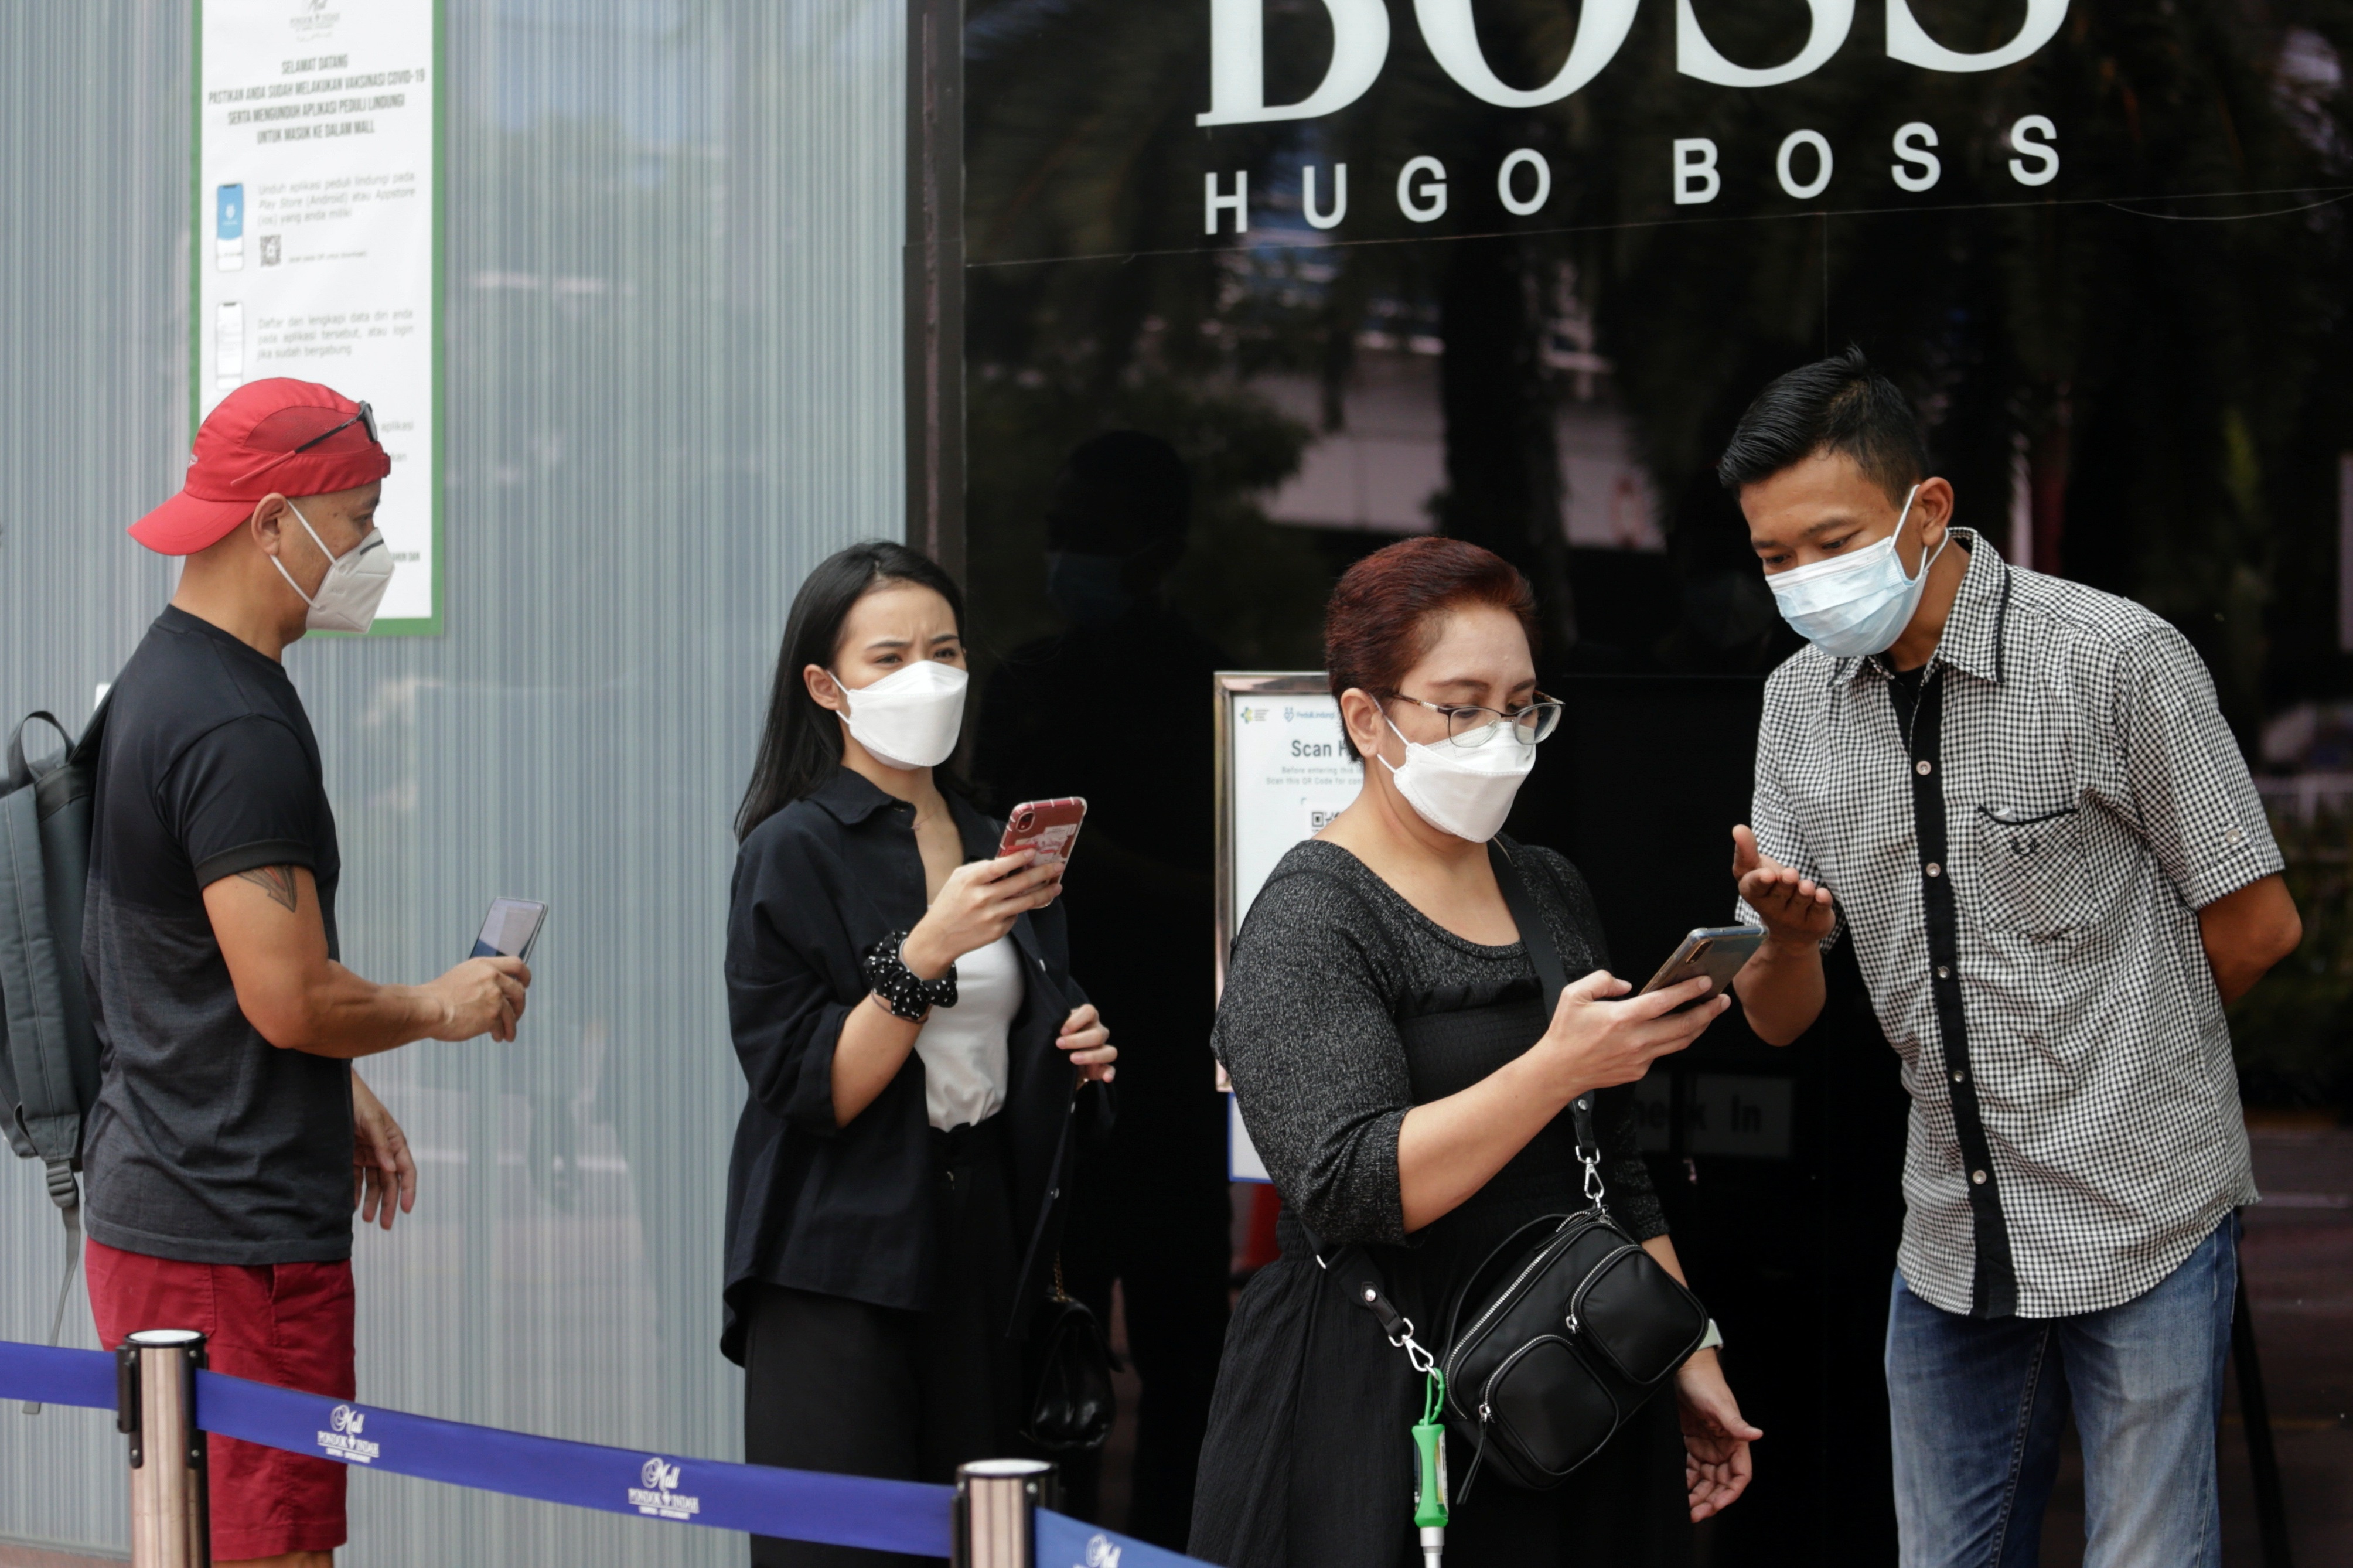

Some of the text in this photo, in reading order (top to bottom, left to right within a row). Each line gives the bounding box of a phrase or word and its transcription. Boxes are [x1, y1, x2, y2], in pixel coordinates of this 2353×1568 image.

[282, 54, 349, 75] SELAMAT DATANG
[209, 89, 244, 105] PASTIKAN
[246, 86, 266, 100] ANDA
[268, 84, 293, 98] SUDAH
[303, 100, 337, 117] APLIKASI
[284, 125, 311, 141] MASUK
[313, 124, 323, 138] KE
[325, 121, 352, 137] DALAM
[354, 120, 375, 134] MALL
[1205, 114, 2059, 235] HUGO BOSS
[1291, 739, 1332, 757] Scan
[1308, 766, 1337, 776] entering
